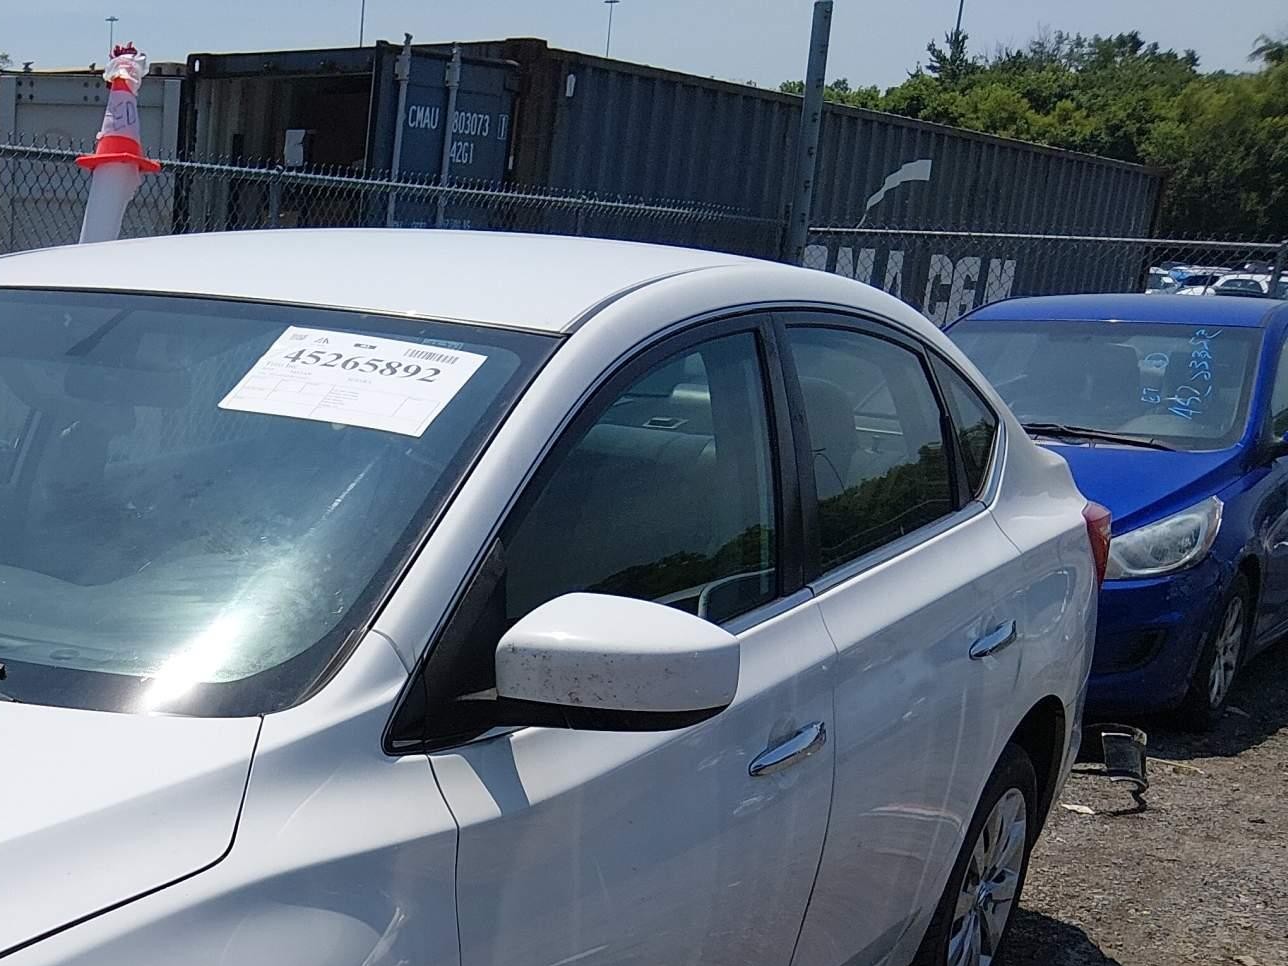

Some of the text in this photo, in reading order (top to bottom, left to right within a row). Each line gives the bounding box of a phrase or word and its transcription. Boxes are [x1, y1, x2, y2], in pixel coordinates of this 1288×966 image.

[408, 106, 440, 129] CMAU
[452, 112, 490, 136] 803073
[450, 141, 474, 164] 42G1
[921, 254, 1017, 329] CGM
[284, 349, 441, 383] 45265892
